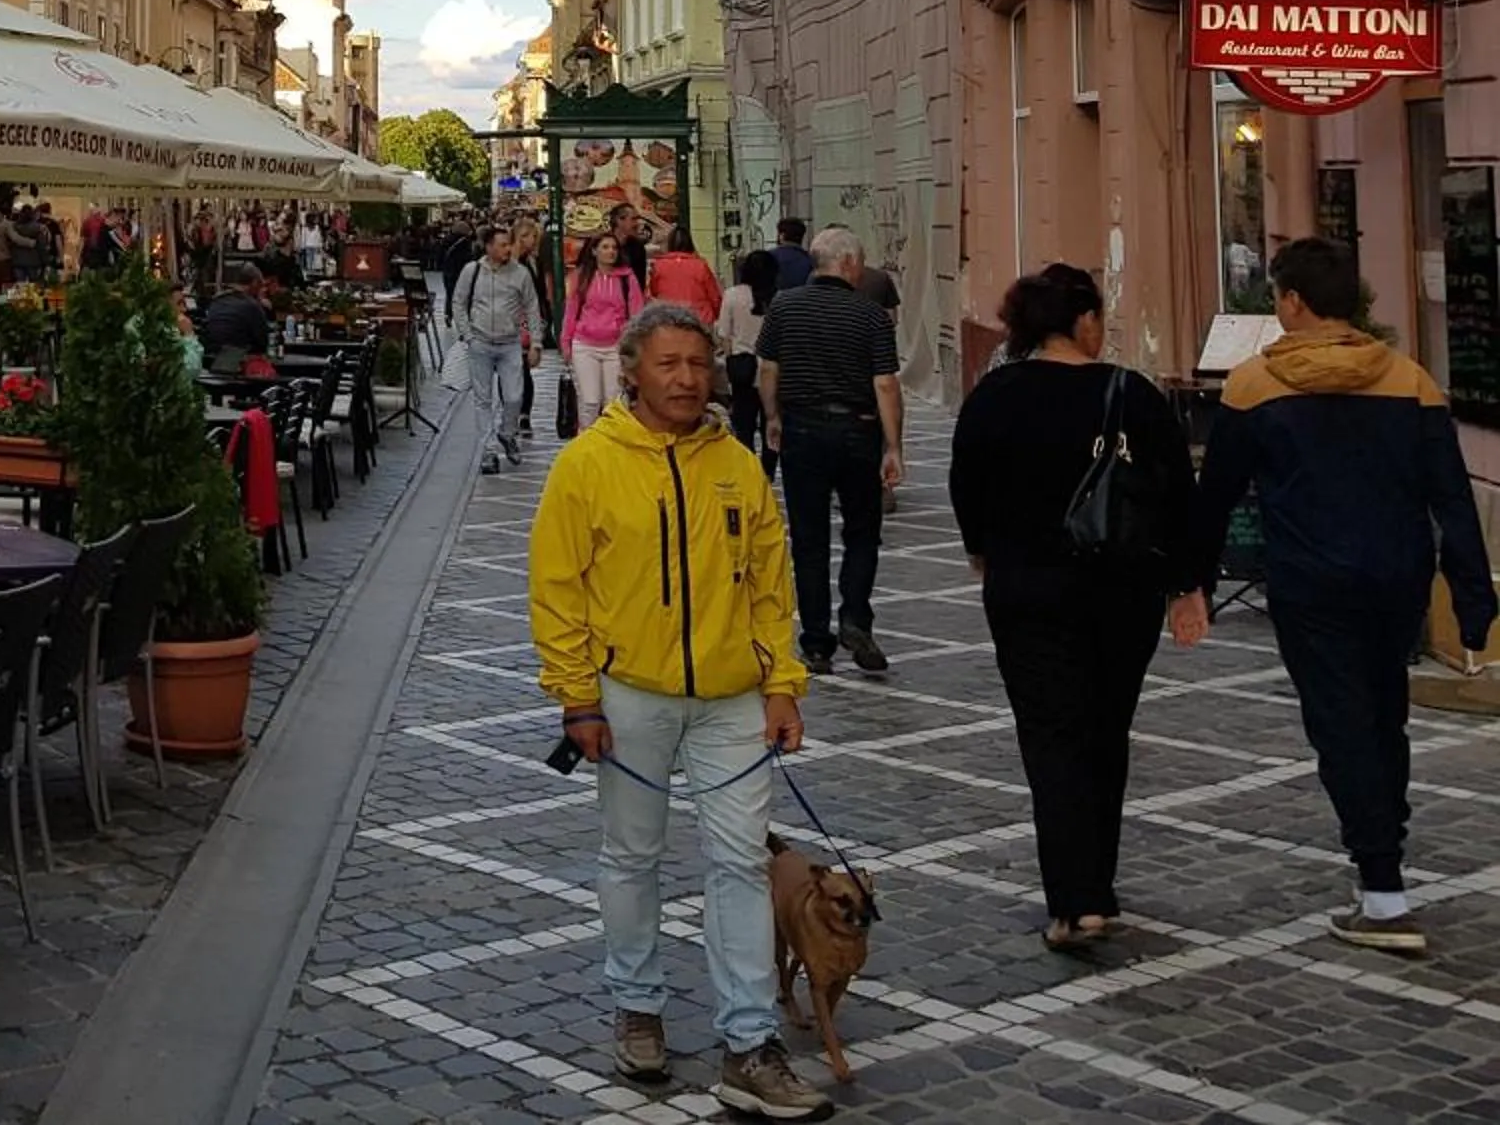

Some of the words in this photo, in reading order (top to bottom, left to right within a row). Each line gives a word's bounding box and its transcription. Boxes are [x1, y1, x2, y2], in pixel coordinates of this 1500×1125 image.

[1200, 4, 1259, 31] DAI
[1272, 5, 1428, 36] MATTONI
[1219, 40, 1309, 58] Restaurant
[1311, 43, 1328, 57] &
[1331, 44, 1370, 60] Wine
[1373, 44, 1405, 61] Bar
